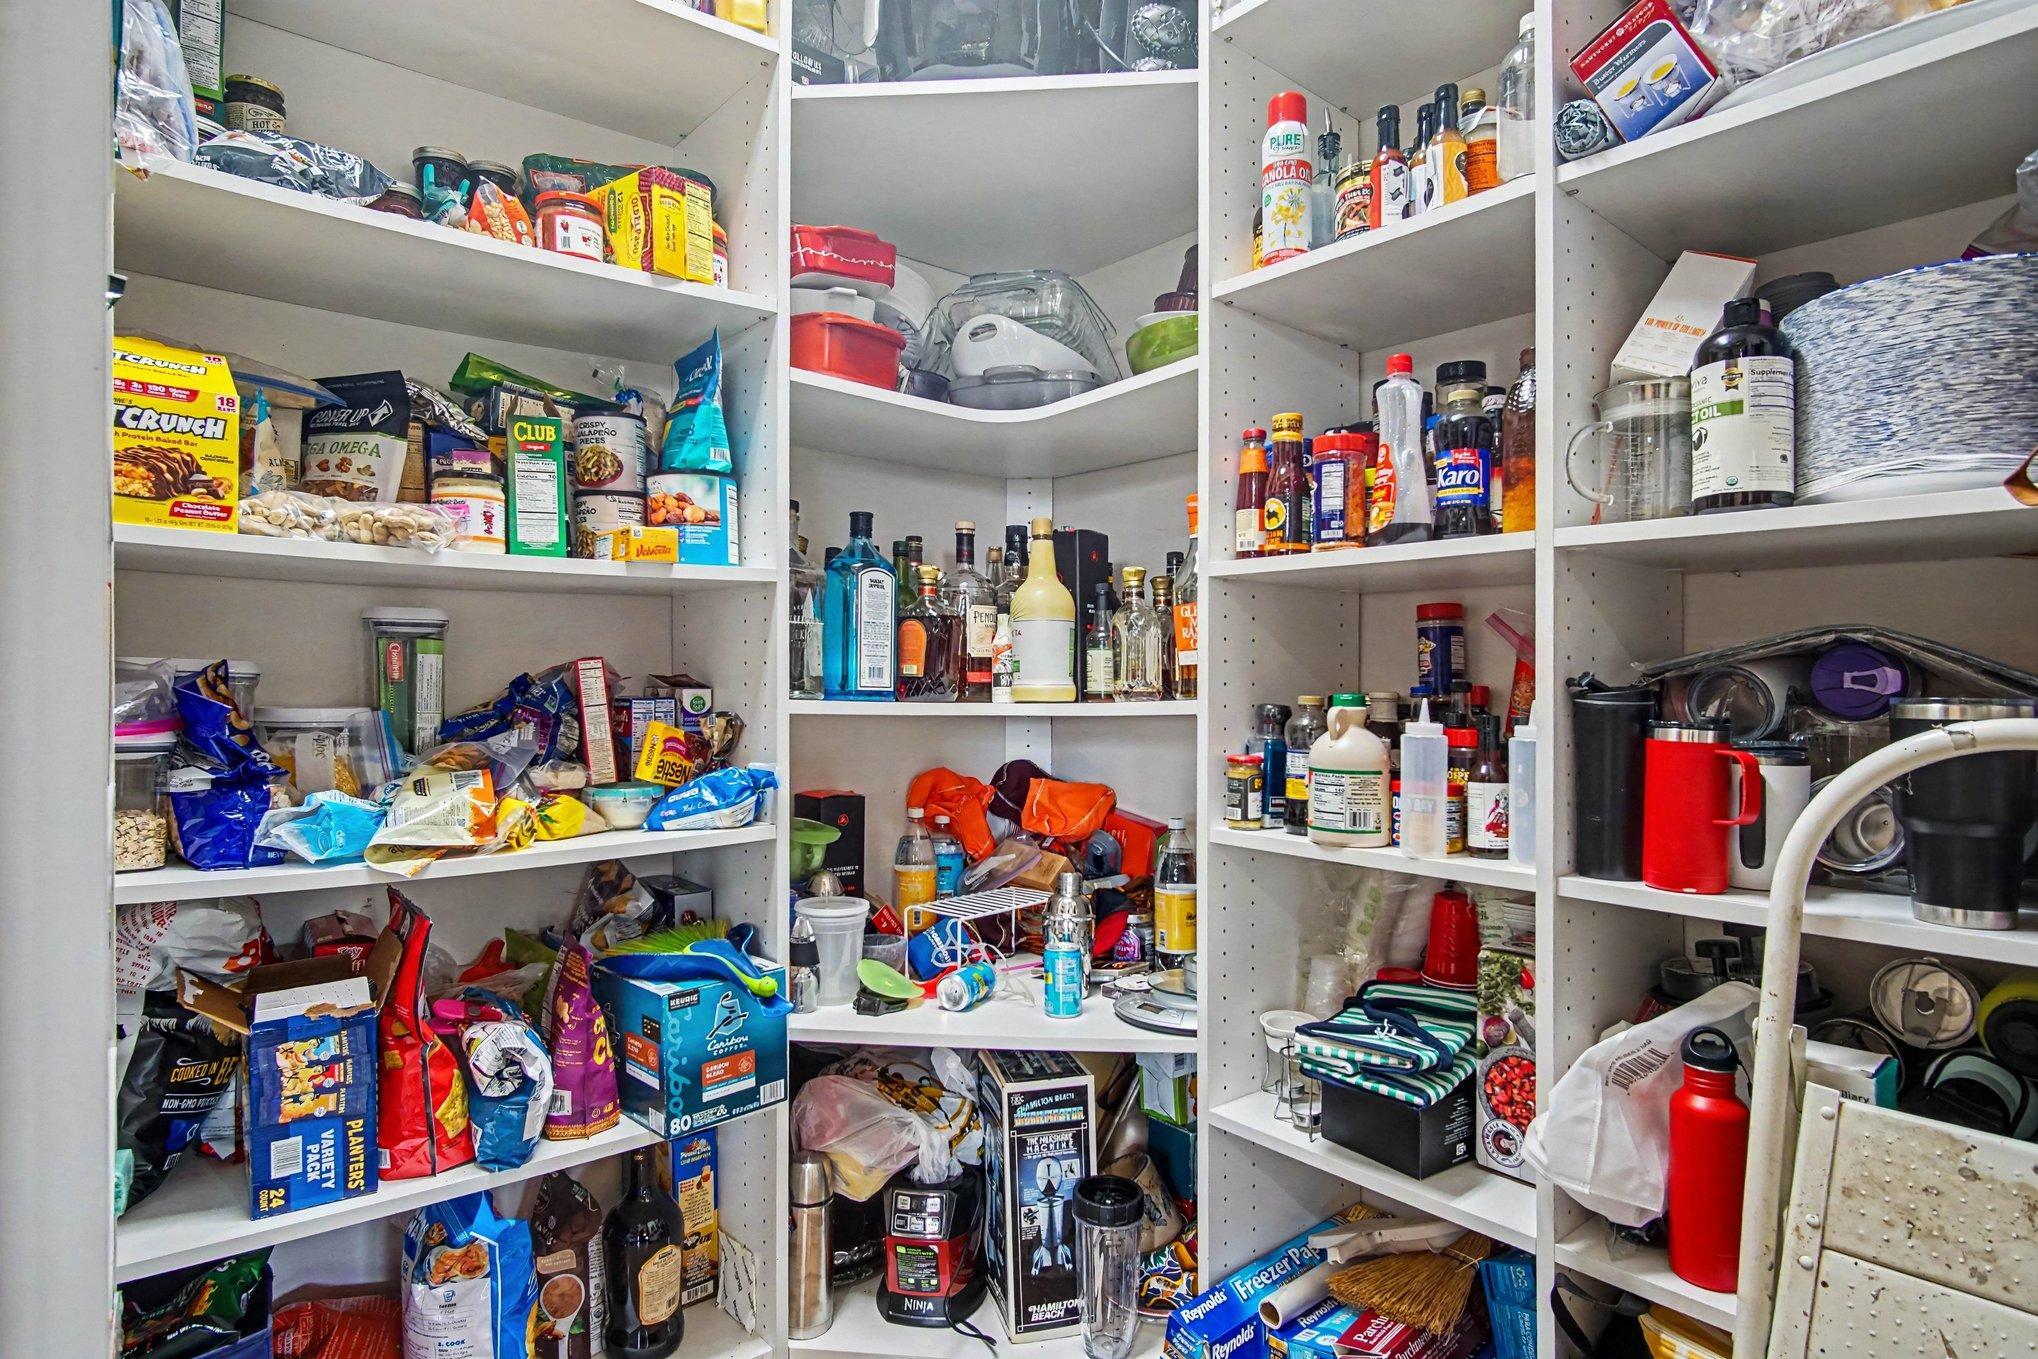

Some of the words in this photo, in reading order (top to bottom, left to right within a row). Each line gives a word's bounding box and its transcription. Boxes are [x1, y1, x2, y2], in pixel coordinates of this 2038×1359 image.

[252, 120, 270, 129] HOT
[1270, 134, 1301, 149] PURE
[217, 396, 236, 407] 18
[309, 408, 352, 424] POWER
[350, 407, 370, 423] UP
[513, 421, 557, 442] CLUB
[578, 421, 606, 429] CRISPY
[121, 432, 154, 442] Protein
[155, 436, 182, 446] Baked
[183, 439, 199, 448] Bar
[579, 437, 606, 445] PIECES
[328, 440, 382, 459] OMEGA
[1437, 467, 1480, 488] Karo
[173, 507, 203, 516] Peanut
[202, 510, 228, 519] Butter
[180, 502, 222, 512] Chocolate
[636, 544, 671, 558] Velveeta
[669, 993, 699, 1007] KEURIG
[707, 1035, 749, 1052] Caribou
[169, 1063, 209, 1083] COOKED
[208, 1060, 220, 1075] IN
[162, 1098, 197, 1109] NON-GMO
[670, 1114, 692, 1135] 80
[346, 1118, 366, 1191] PLANTERS
[1026, 1140, 1074, 1154] MACHINE
[306, 1143, 321, 1183] PACK
[320, 1128, 336, 1190] VARIETY
[259, 1189, 269, 1212] COUNT
[269, 1188, 286, 1209] 24
[1234, 1256, 1293, 1301] Freezer
[1287, 1243, 1321, 1266] Pap
[904, 1297, 934, 1314] NINJA
[1180, 1289, 1228, 1324] Reynolds
[1297, 1299, 1339, 1329] Reynold
[1031, 1309, 1065, 1322] BEACH
[445, 1339, 466, 1347] COOK
[1212, 1324, 1254, 1359] Reynolds
